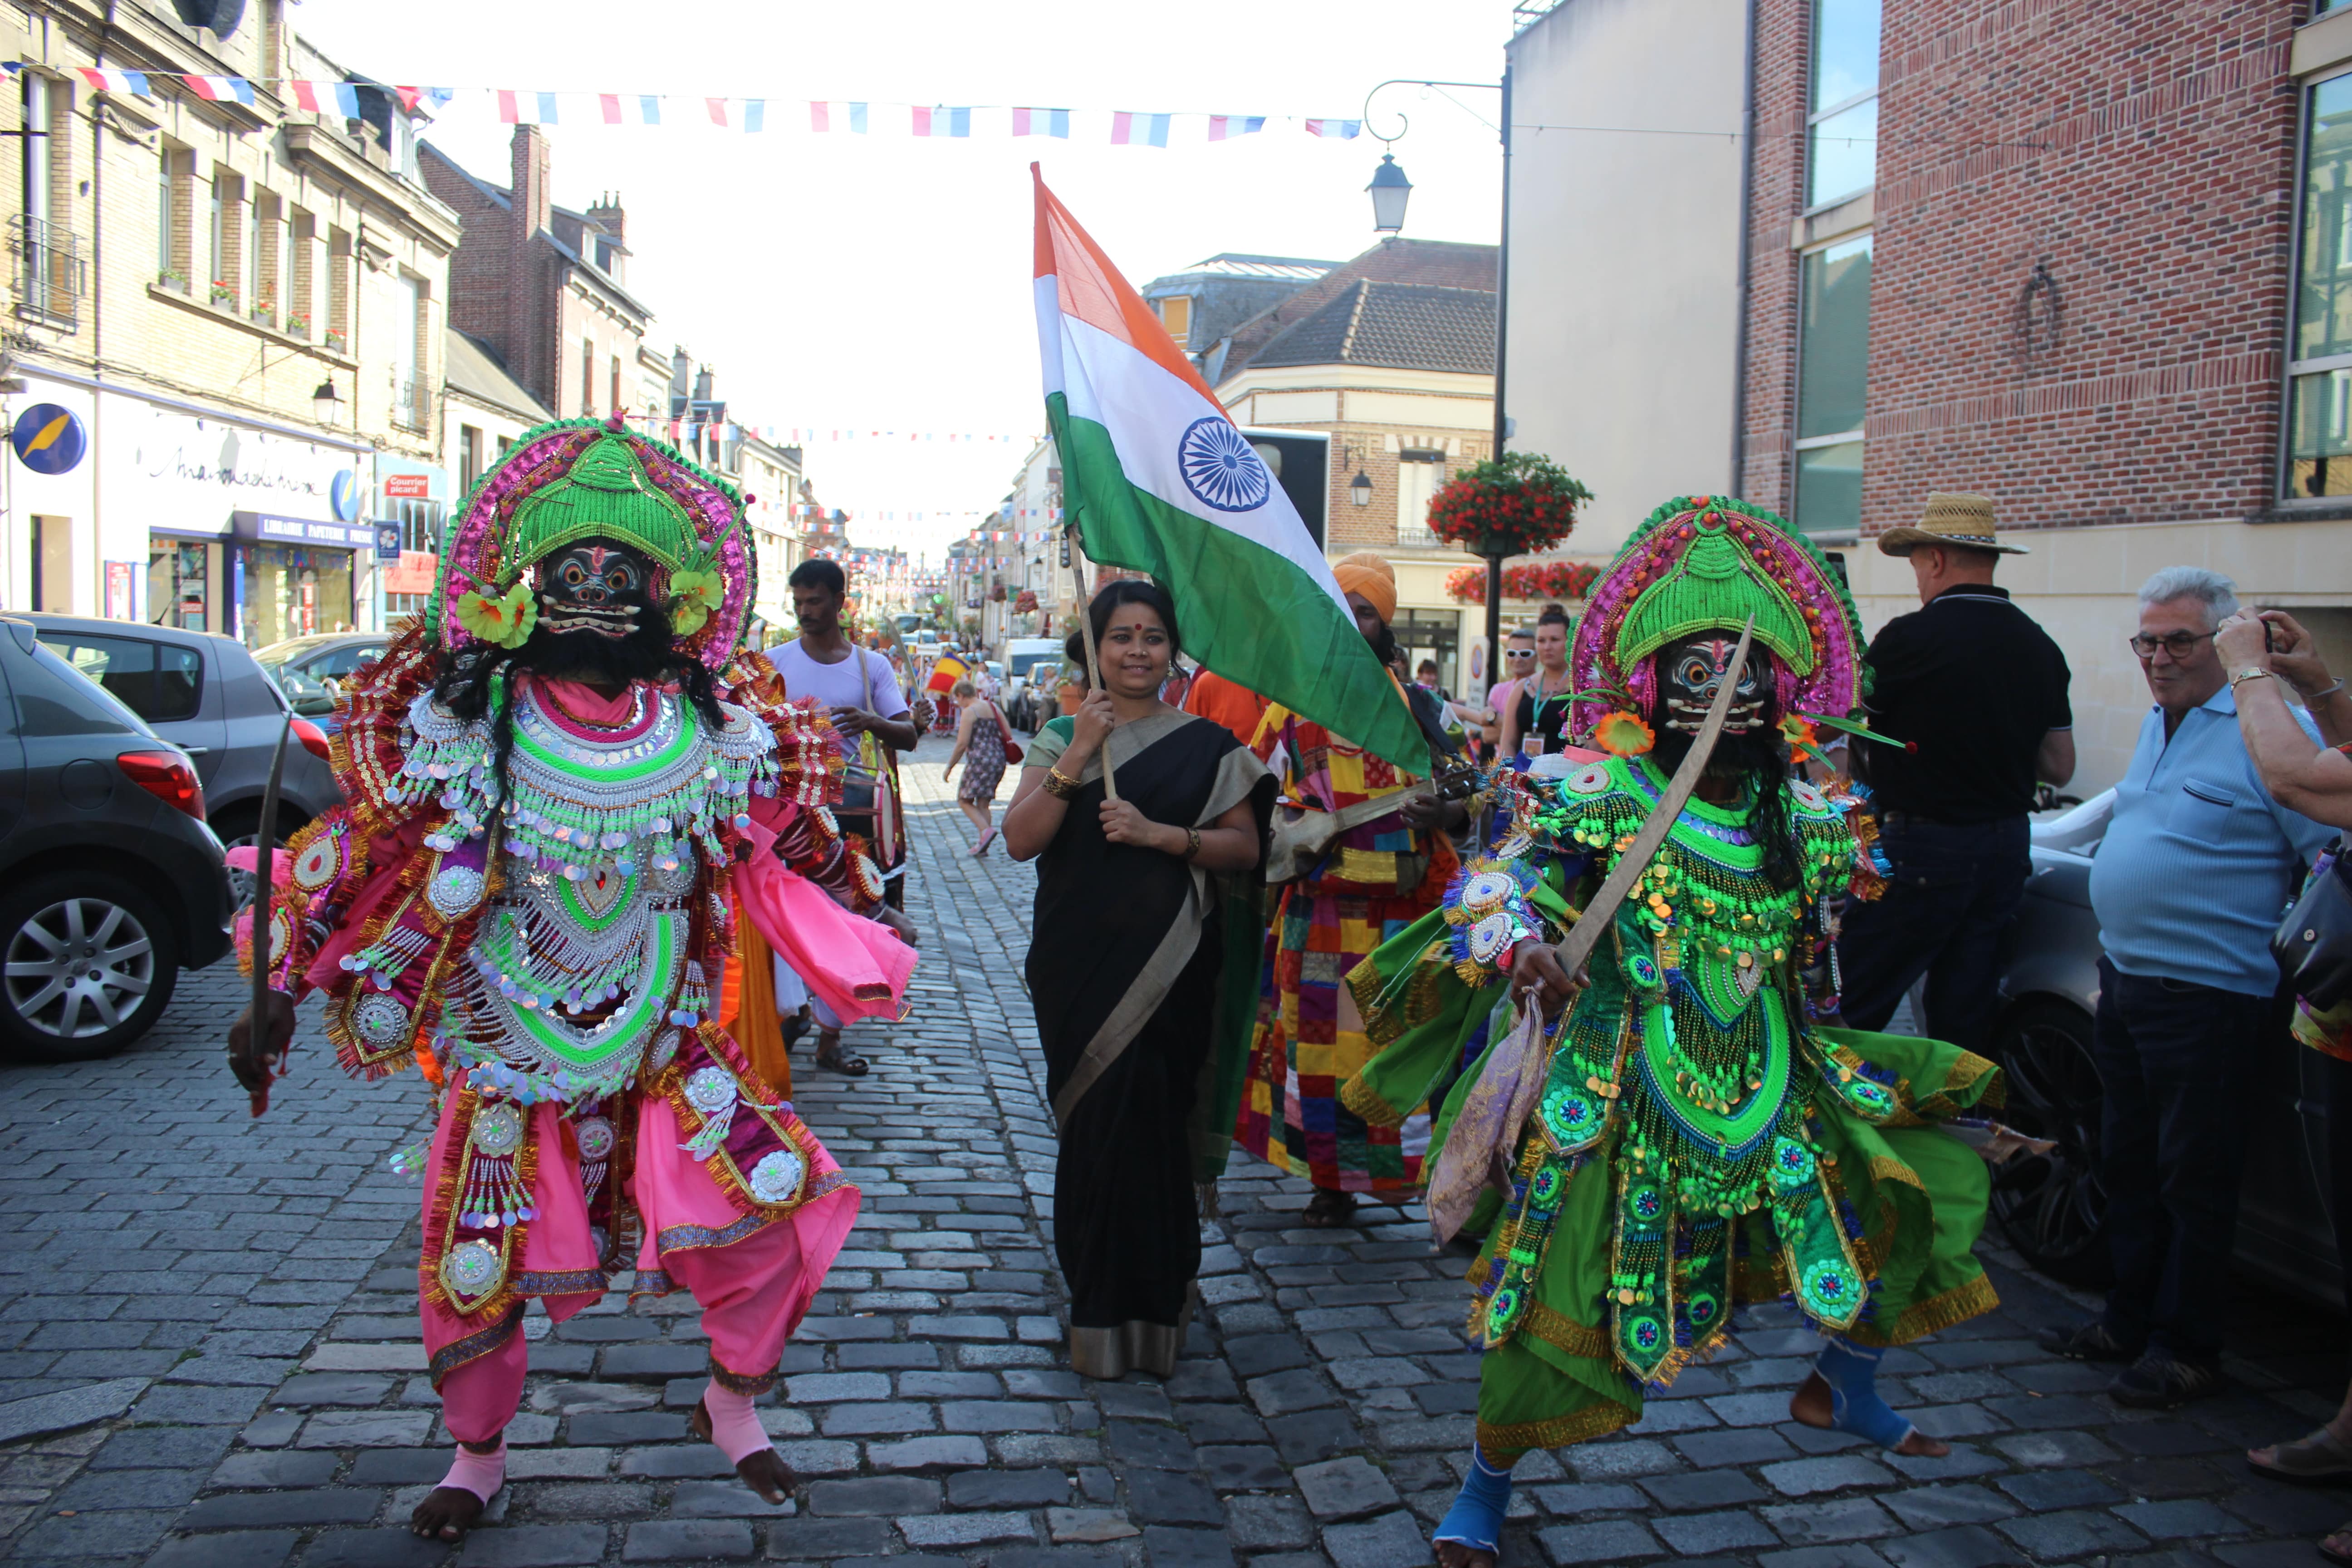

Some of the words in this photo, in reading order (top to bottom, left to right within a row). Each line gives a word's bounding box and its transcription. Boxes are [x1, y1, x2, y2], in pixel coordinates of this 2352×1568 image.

[390, 477, 427, 486] Courrier
[264, 519, 304, 537] LIBRAIRIE
[308, 524, 346, 541] PAPETERIE
[350, 529, 374, 544] PRESSE
